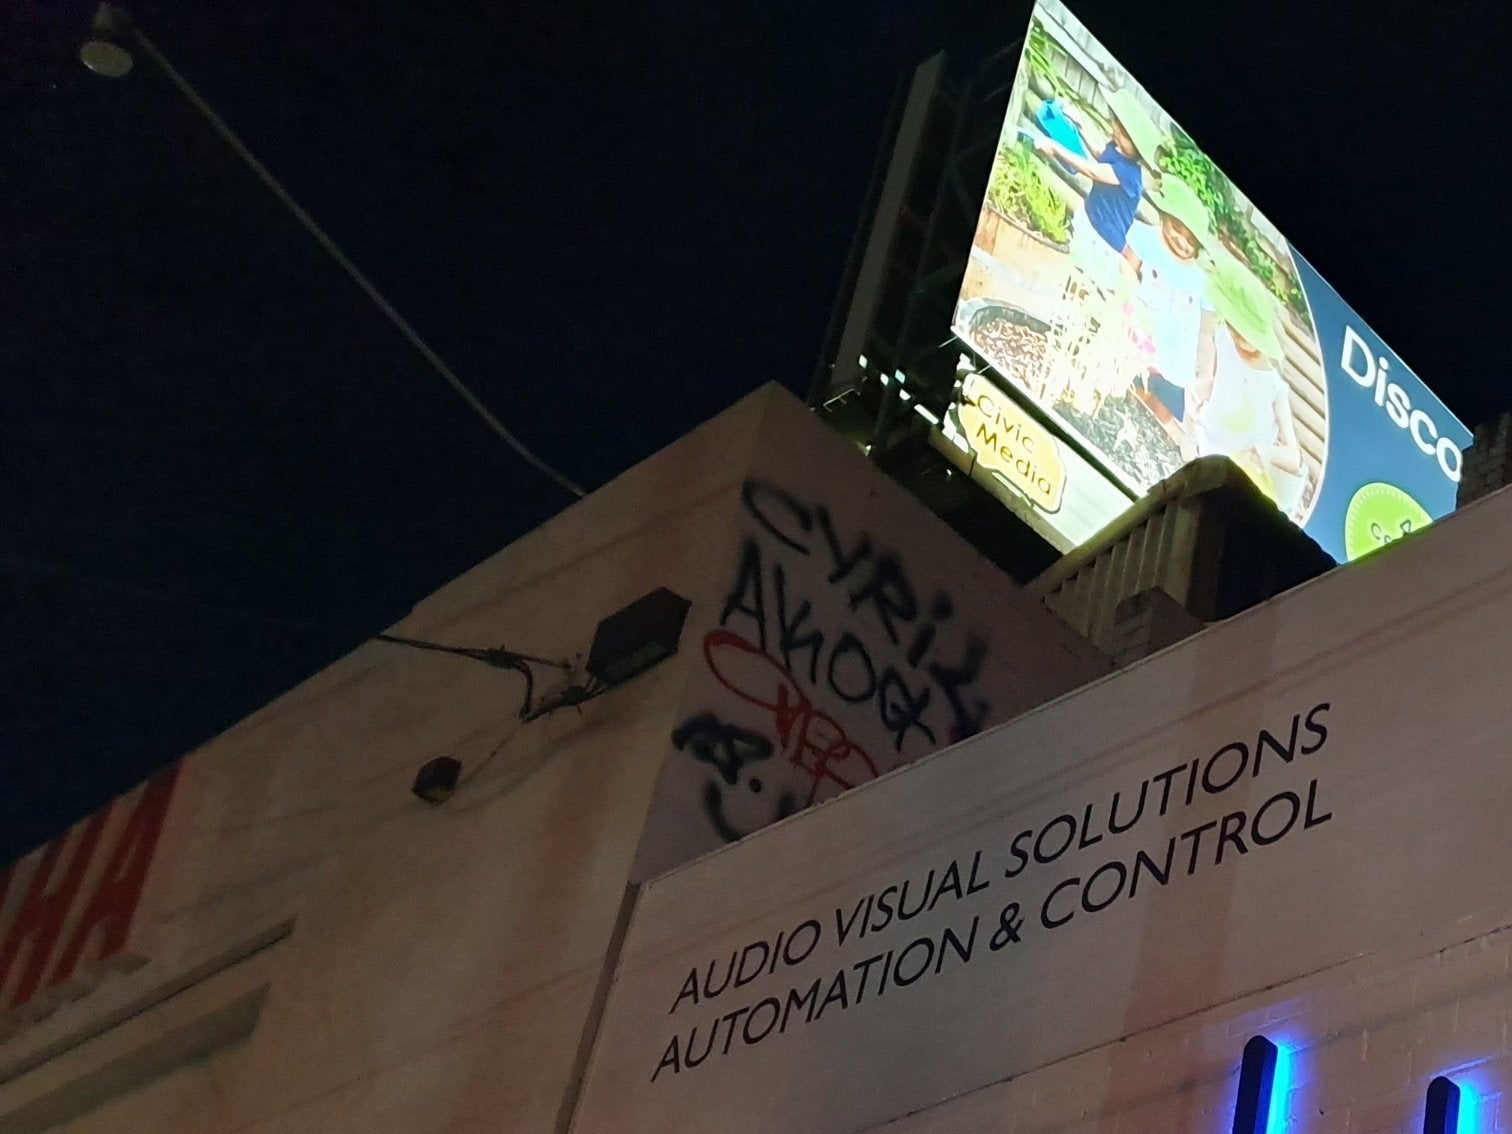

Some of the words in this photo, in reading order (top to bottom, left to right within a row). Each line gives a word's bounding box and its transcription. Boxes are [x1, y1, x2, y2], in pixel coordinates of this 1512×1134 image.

[976, 422, 1051, 495] Media
[977, 394, 1035, 454] Civic
[1341, 325, 1463, 483] Disco
[650, 915, 980, 1083] AUTOMATION
[989, 902, 1025, 952] &
[1040, 778, 1333, 930] CONTROL
[668, 919, 822, 1015] AUDIO
[836, 849, 991, 947] VISUAL
[1004, 702, 1331, 879] SOLUTIONS
